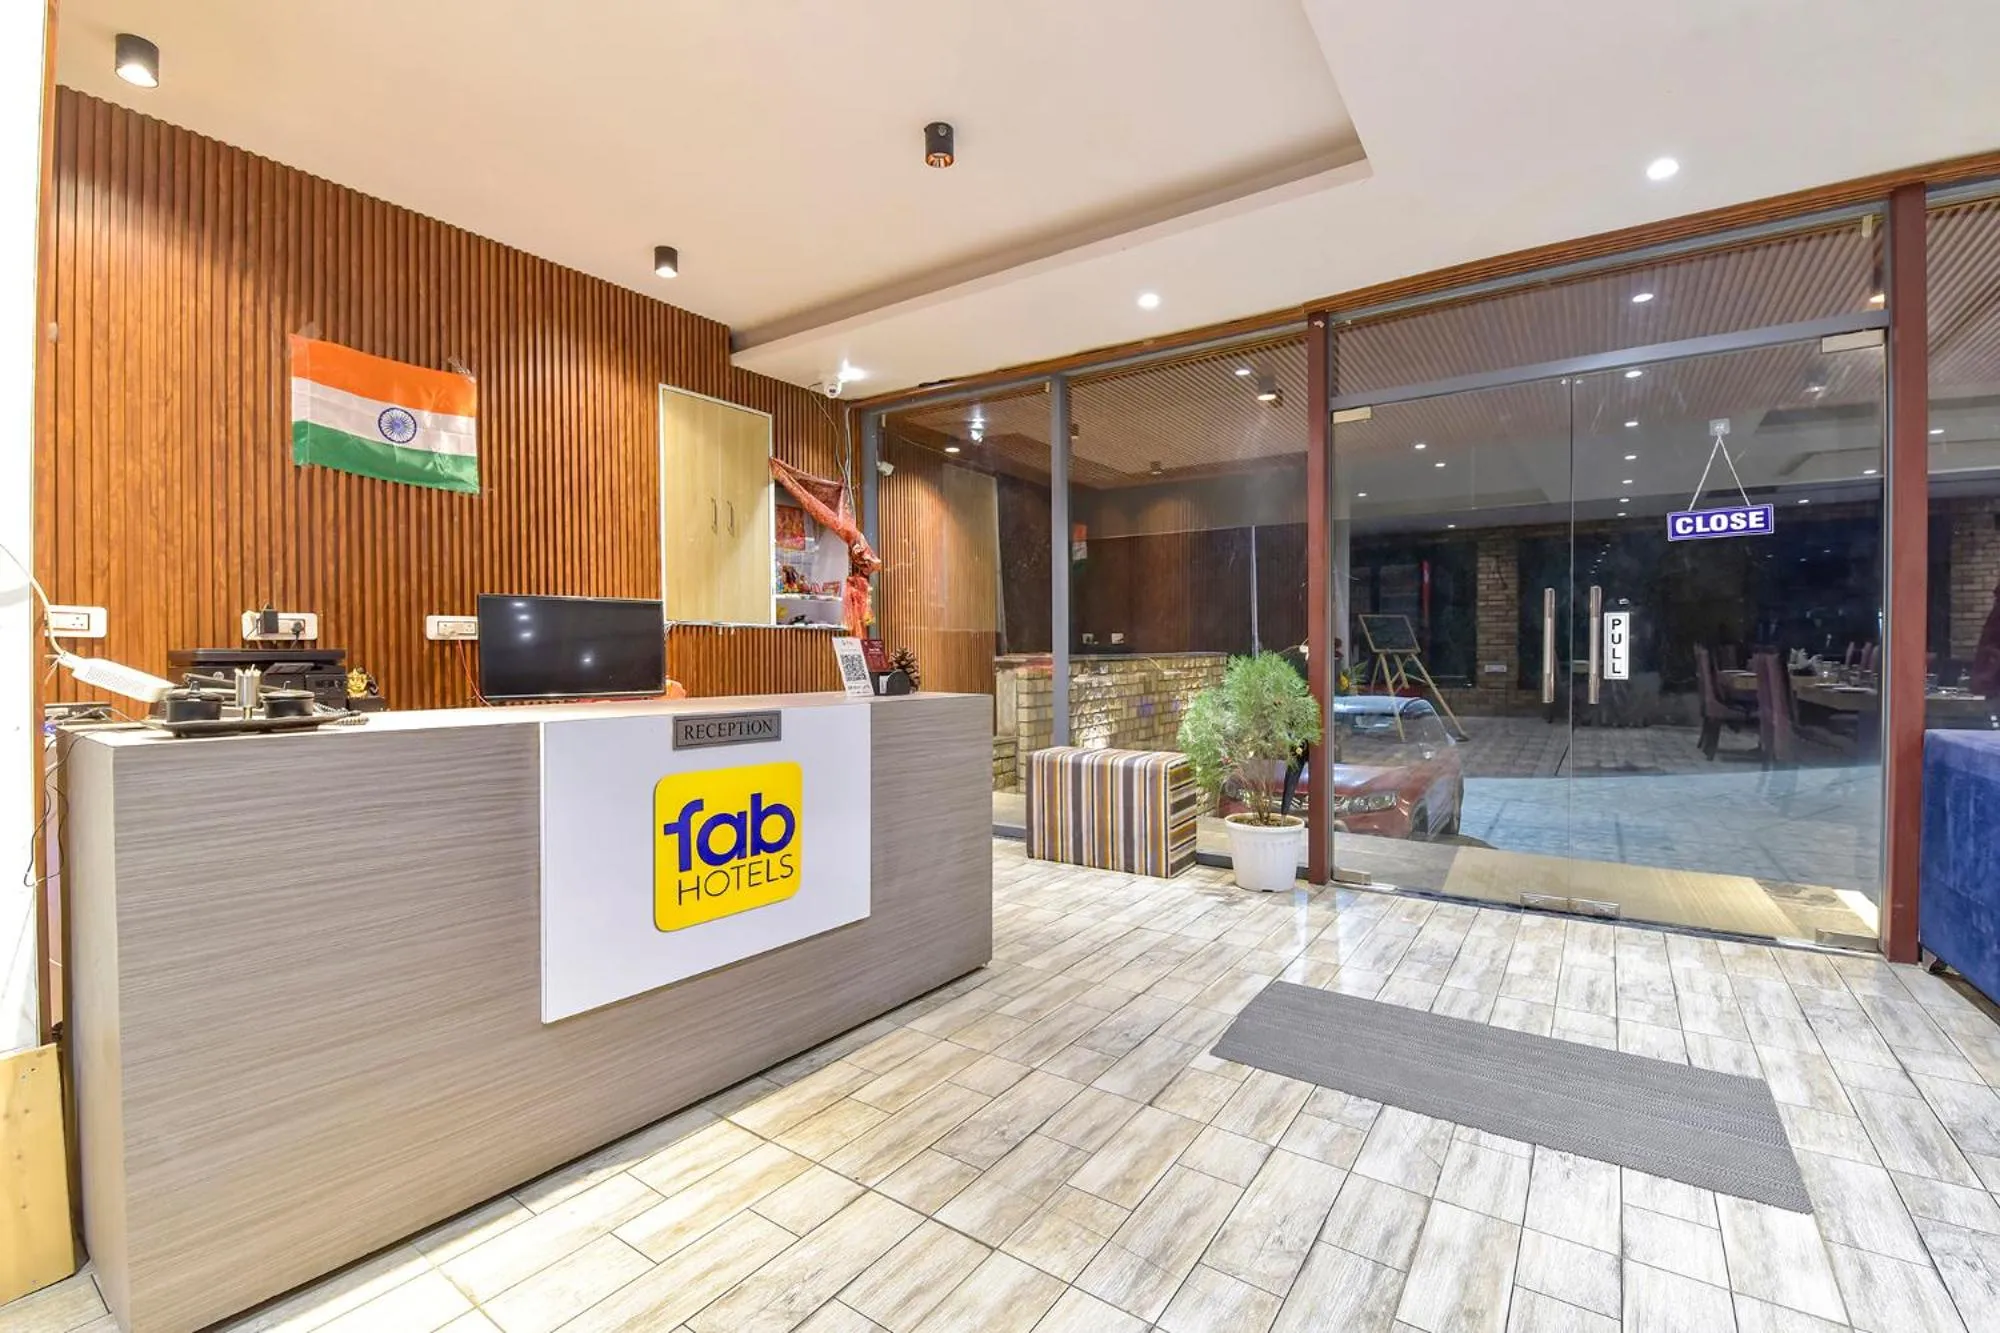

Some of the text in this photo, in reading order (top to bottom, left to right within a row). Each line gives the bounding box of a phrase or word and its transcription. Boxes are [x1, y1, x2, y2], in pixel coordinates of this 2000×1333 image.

[1675, 510, 1765, 534] CLOSE
[1611, 618, 1622, 674] PULL
[684, 718, 773, 740] RECEPTION
[664, 792, 796, 872] fab
[678, 854, 794, 906] HOTELS
